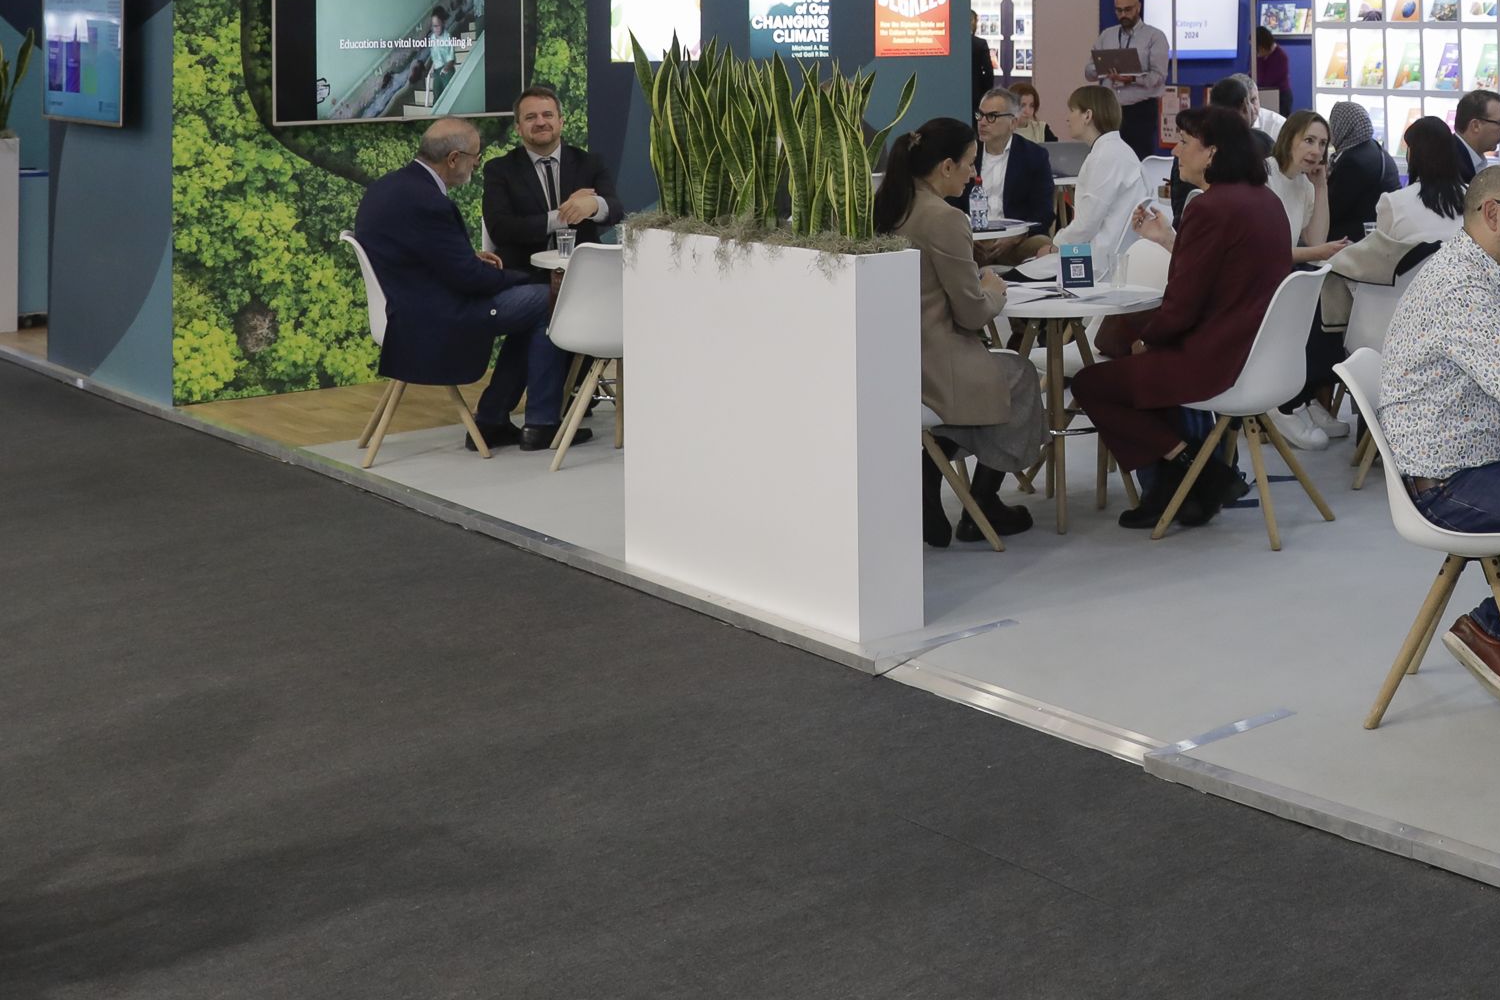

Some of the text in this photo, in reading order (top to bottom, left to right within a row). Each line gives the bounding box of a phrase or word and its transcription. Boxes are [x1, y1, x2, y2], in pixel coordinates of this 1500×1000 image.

[795, 2, 830, 15] of Our
[751, 14, 830, 30] CHANGING
[772, 28, 830, 43] CLIMATE
[339, 38, 379, 49] Education
[380, 38, 386, 48] is
[394, 37, 412, 48] vital
[412, 37, 428, 48] tool
[436, 37, 466, 50] tackling
[466, 37, 473, 47] it
[1073, 246, 1079, 255] 6
